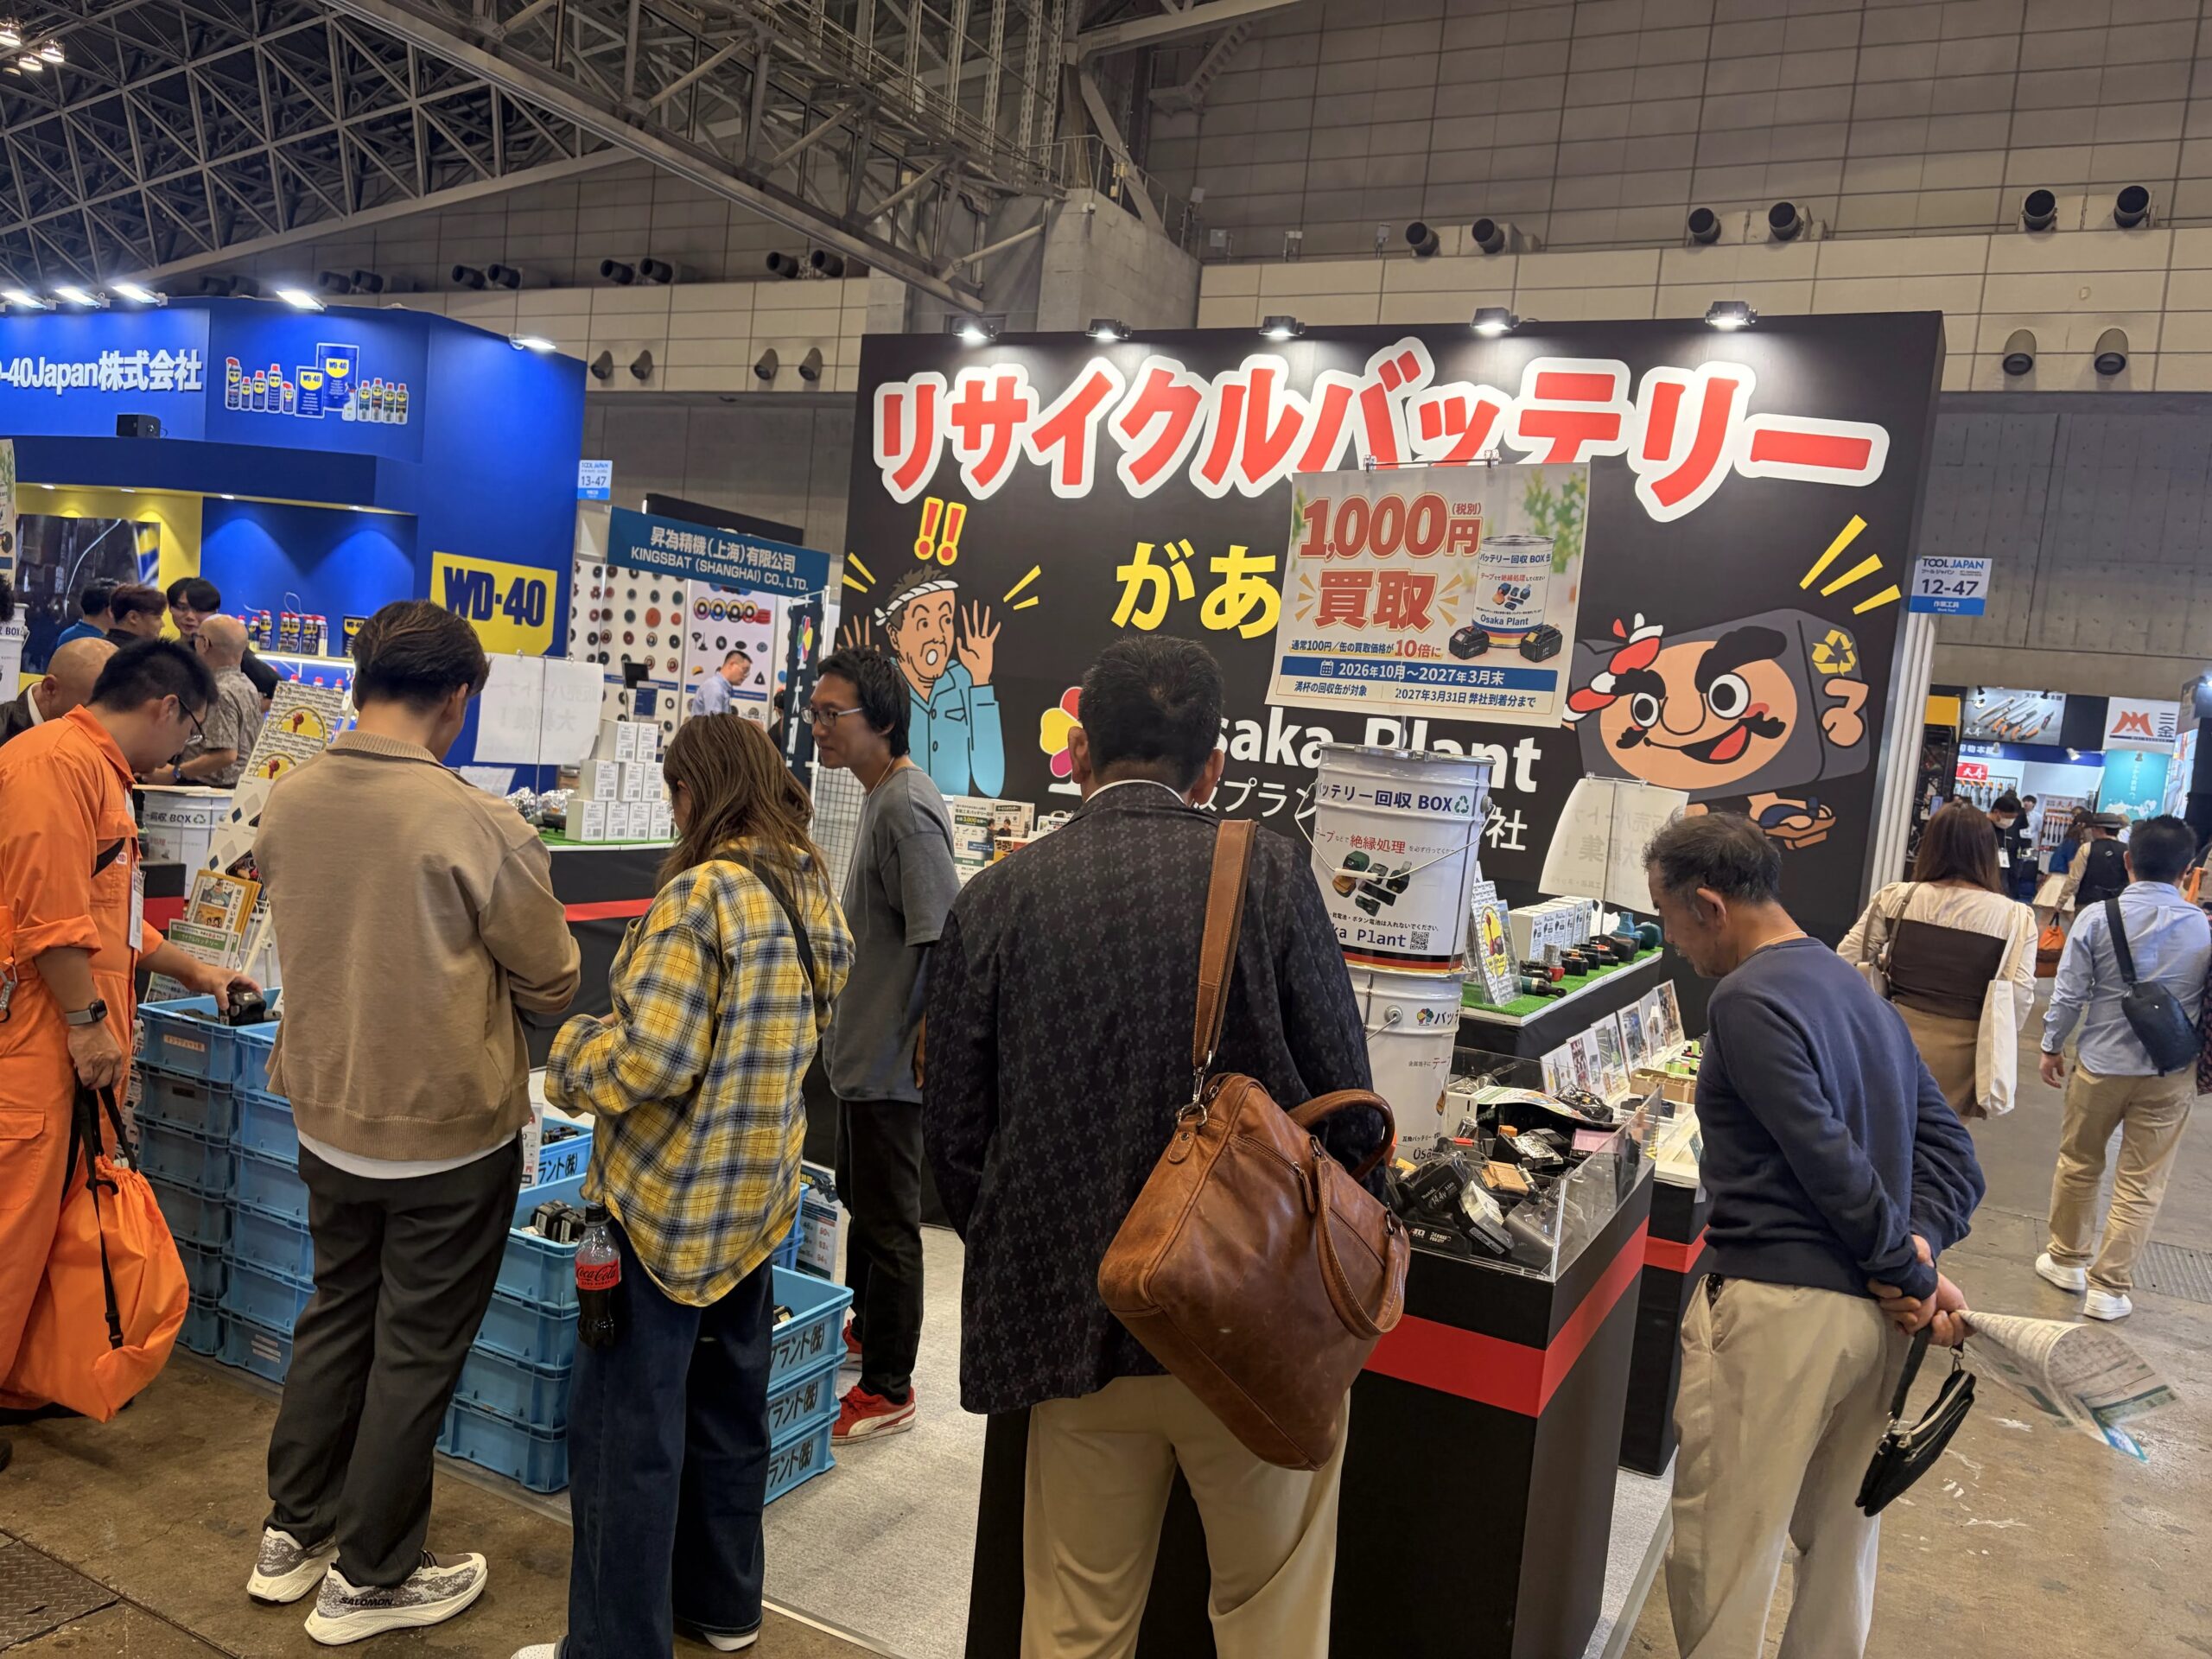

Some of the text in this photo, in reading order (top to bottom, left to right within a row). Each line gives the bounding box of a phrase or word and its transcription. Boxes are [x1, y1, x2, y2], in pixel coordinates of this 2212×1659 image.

[0, 349, 203, 396] -40Japan株式会社
[874, 339, 1891, 522] リサイクルバッテリー
[581, 475, 607, 486] 13-47
[1451, 501, 1482, 516] (税別)
[1298, 493, 1483, 562] 1,000円
[1529, 554, 1545, 563] BOX
[1923, 558, 1985, 569] TOOL JAPAN
[631, 546, 810, 592] KINGSBAT (SHANGHAI) CO., LTD.
[1111, 539, 1282, 639] があ
[1922, 578, 1980, 596] 12-47
[443, 566, 547, 628] WD-40
[1313, 568, 1440, 635] 買取
[1480, 613, 1529, 626] Osaka Plant
[5, 626, 20, 636] BOX
[1294, 681, 1368, 696] 満杯の回収缶が対象
[1395, 688, 1536, 709] 2027年3月31日 弊社到着分まで
[1418, 795, 1453, 812] BOX
[169, 813, 191, 823] BOX
[1485, 806, 1528, 851] 社
[1357, 929, 1407, 948] Plant
[576, 1264, 616, 1282] Coca-Cola
[340, 1596, 394, 1607] SALOMON
